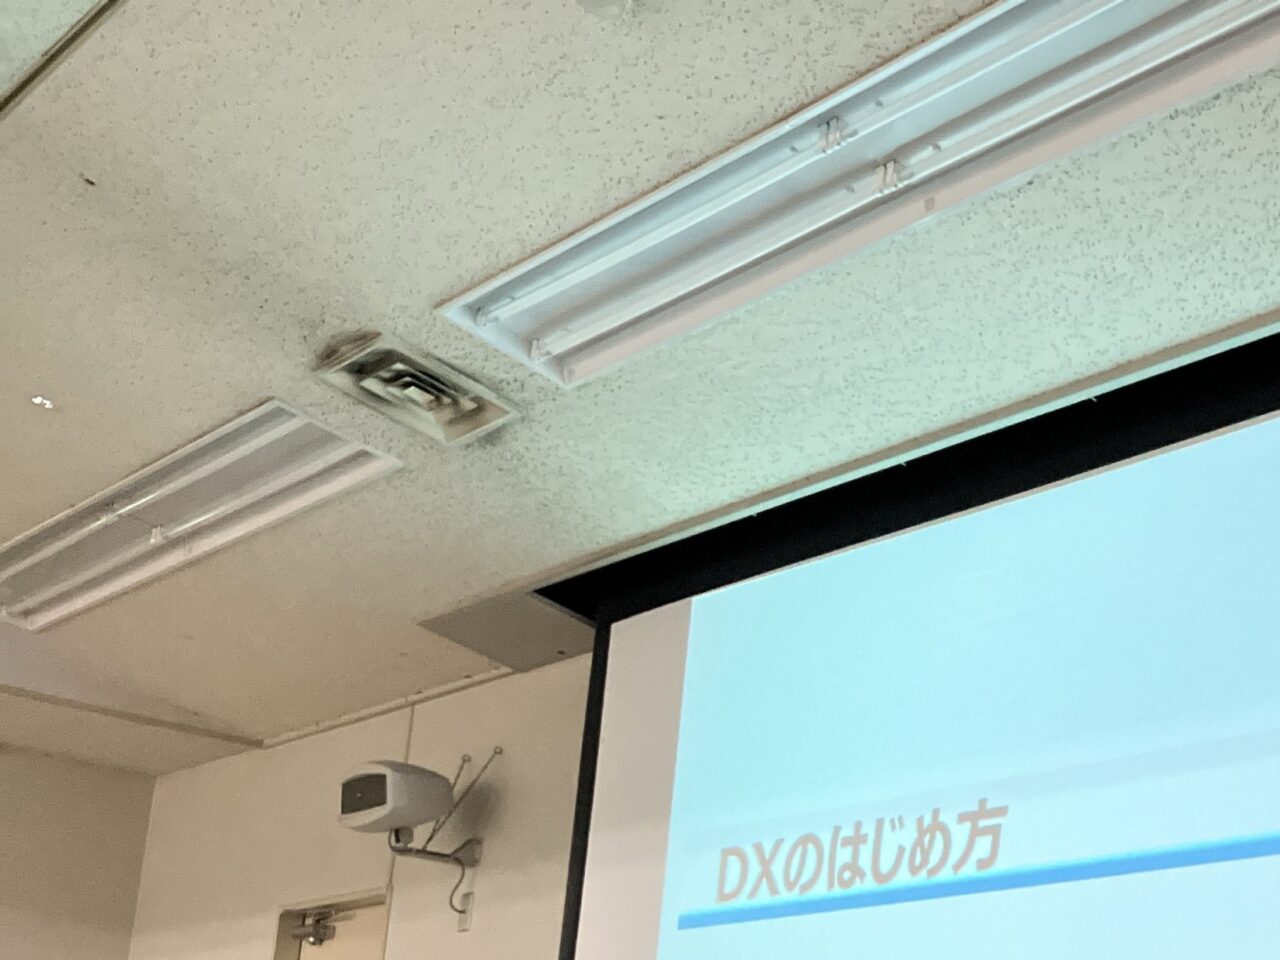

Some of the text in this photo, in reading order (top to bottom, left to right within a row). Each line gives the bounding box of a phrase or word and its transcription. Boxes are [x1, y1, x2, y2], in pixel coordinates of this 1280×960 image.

[715, 797, 1009, 903] DXのはじめ方
